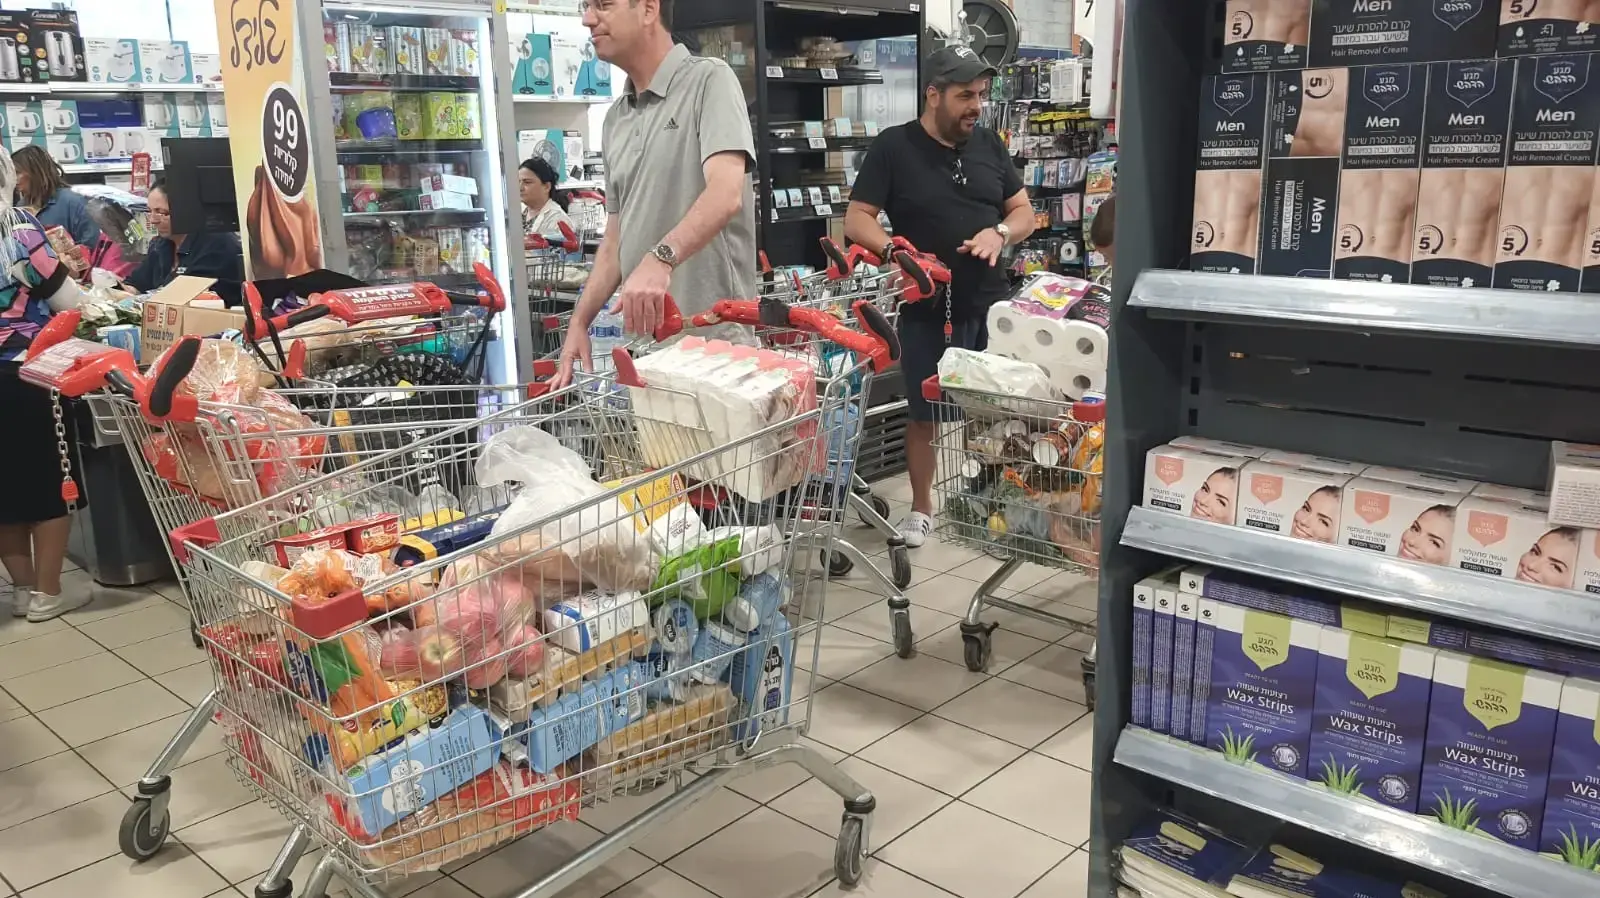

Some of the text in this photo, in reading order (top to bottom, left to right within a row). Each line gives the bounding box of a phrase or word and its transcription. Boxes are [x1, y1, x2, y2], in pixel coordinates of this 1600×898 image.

[1352, 0, 1392, 13] Men
[1510, 0, 1523, 13] 5
[1232, 23, 1241, 36] 5
[1391, 20, 1411, 30] קרם
[1349, 48, 1381, 56] Removal
[1383, 46, 1409, 54] Cream
[1310, 77, 1322, 87] 5
[1365, 116, 1400, 128] Men
[1448, 113, 1485, 125] Men
[1536, 109, 1576, 122] Men
[273, 99, 299, 150] 99
[1215, 121, 1245, 132] Men
[1238, 158, 1258, 166] Cream
[1391, 157, 1415, 165] Cream
[1427, 156, 1500, 165] Hair Removal Cream
[1272, 195, 1281, 226] Removal
[1311, 197, 1326, 233] Men
[1195, 231, 1204, 243] 5
[1271, 228, 1279, 250] Cream
[1340, 236, 1351, 248] 5
[1418, 237, 1430, 249] 5
[1502, 238, 1514, 251] 5
[1227, 687, 1294, 714] Wax Strips
[1340, 710, 1396, 730] רצועות שעווה
[1330, 716, 1360, 734] Wax
[1364, 725, 1403, 745] Strips
[1456, 740, 1519, 762] רצועות שעווה
[1445, 746, 1478, 766] Wax
[1481, 757, 1526, 778] Strips
[1571, 781, 1600, 800] Wa
